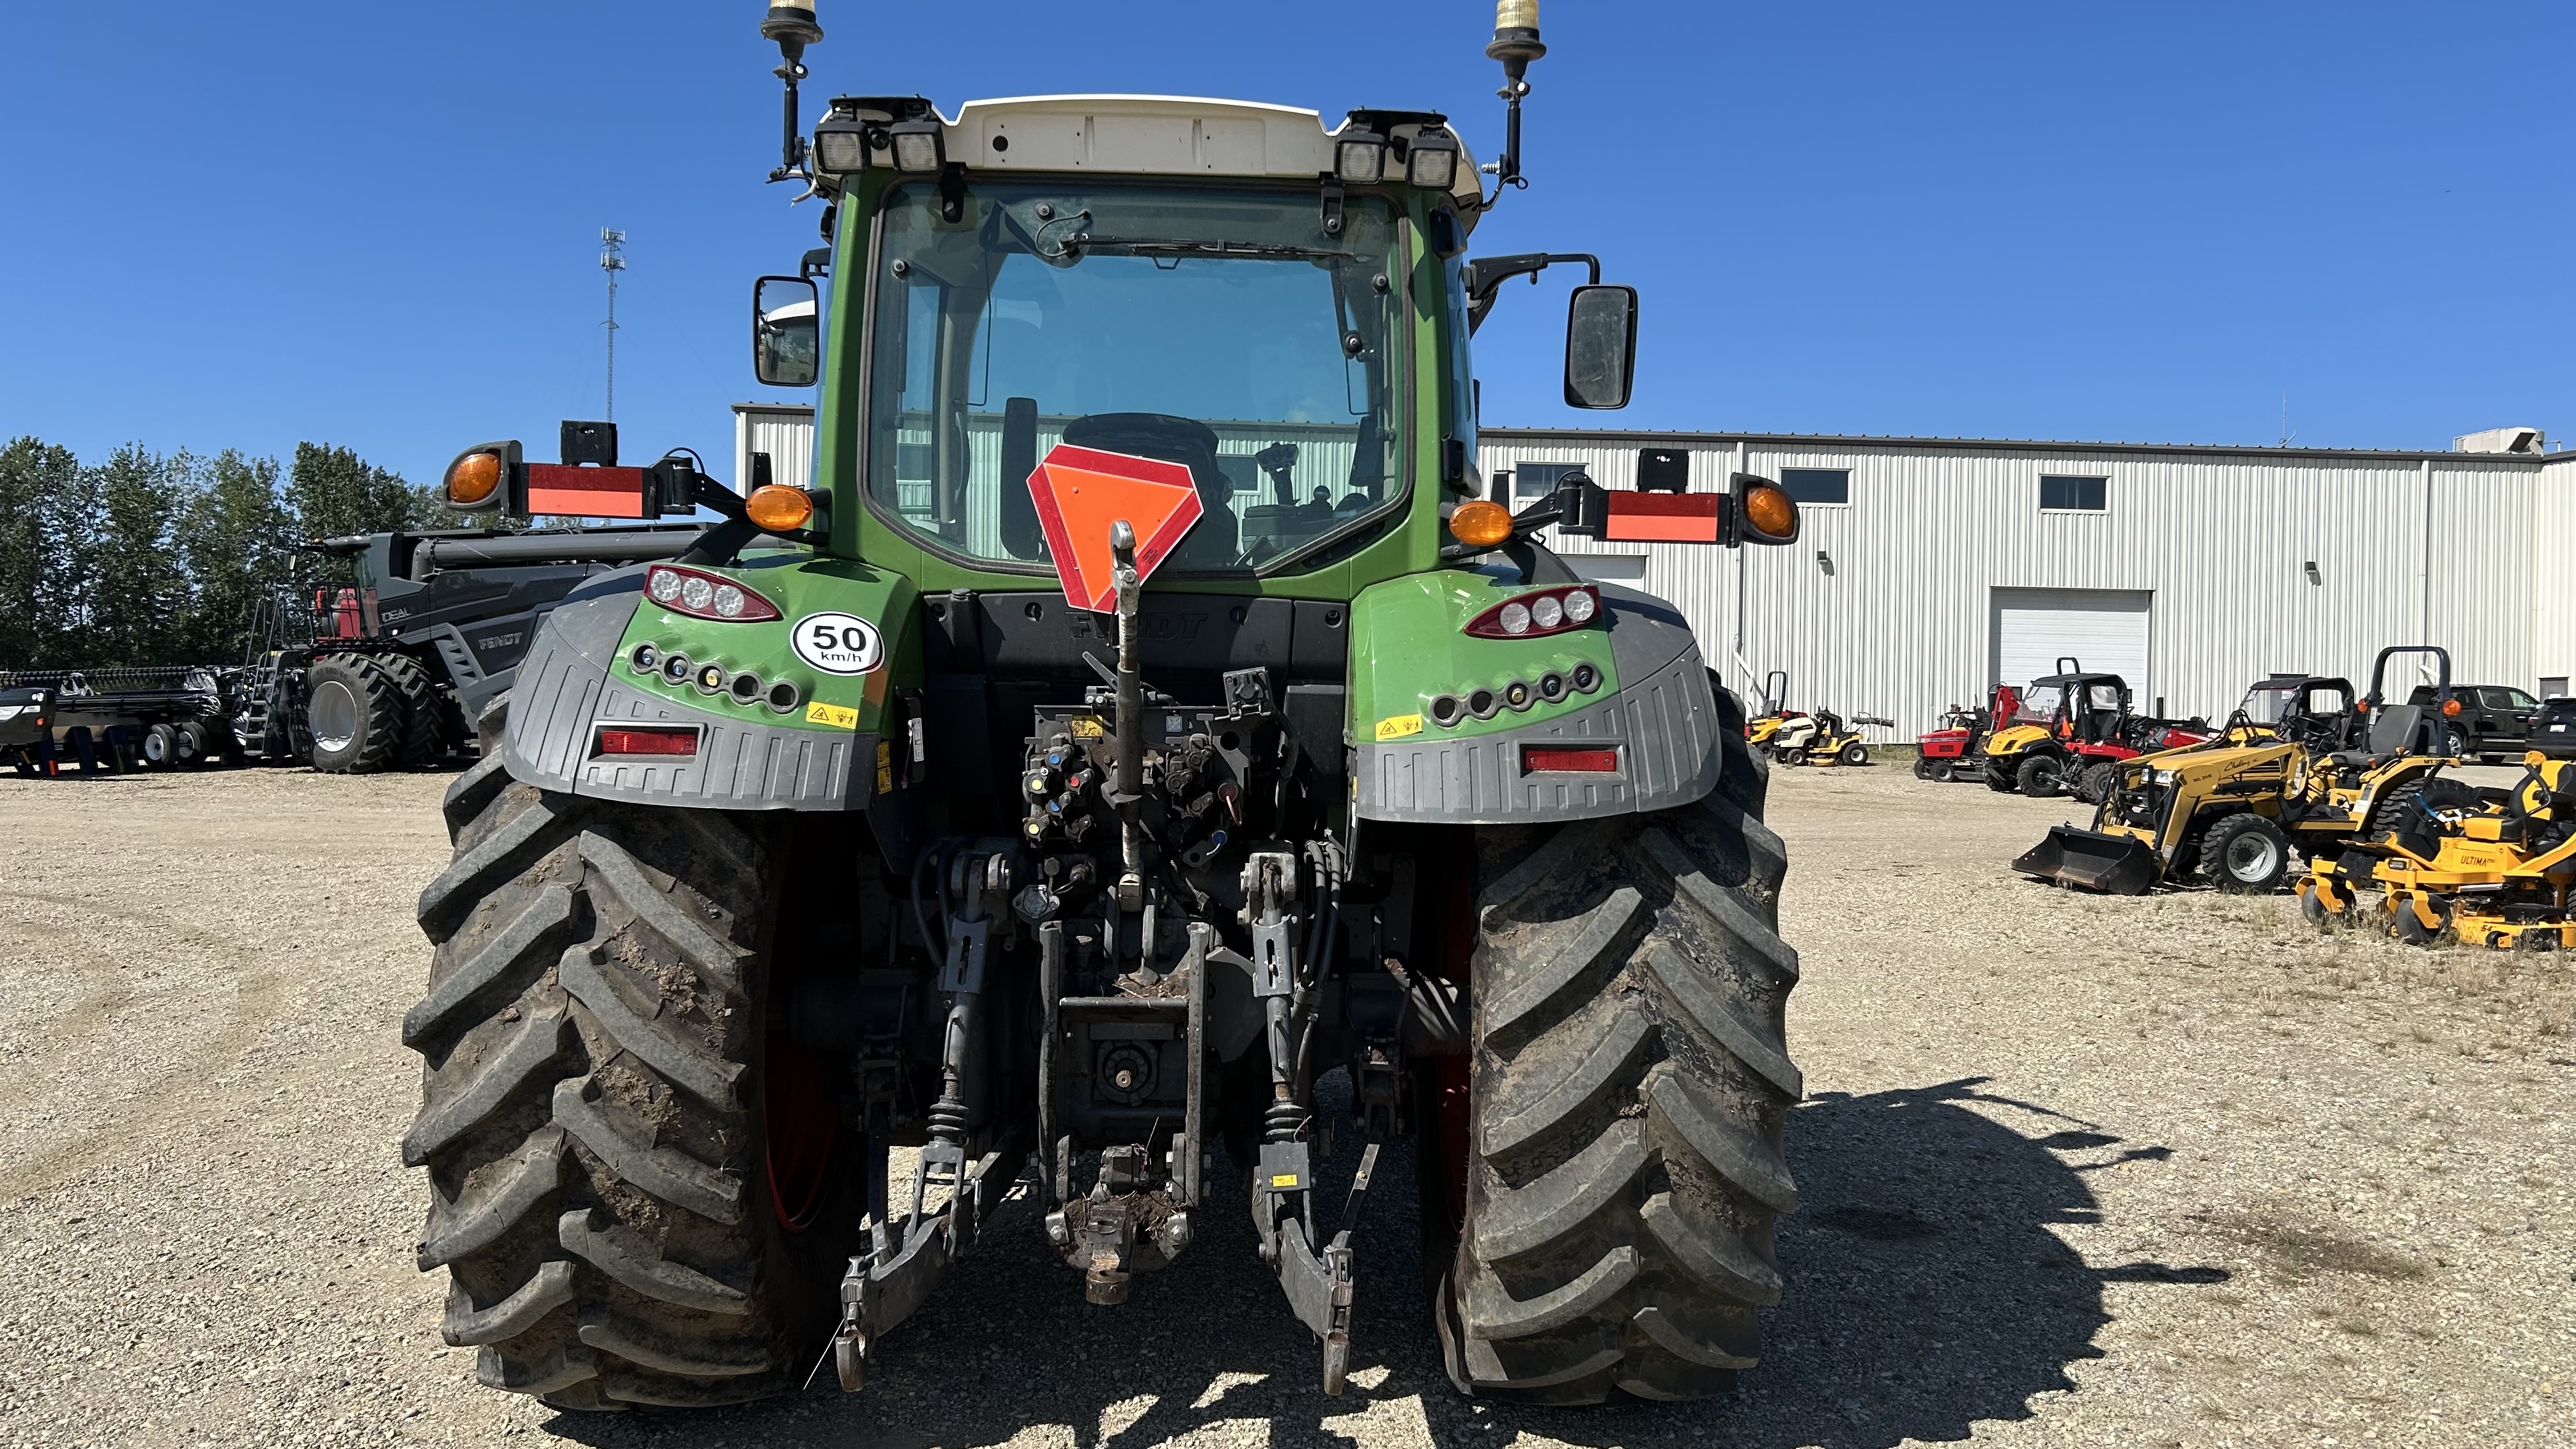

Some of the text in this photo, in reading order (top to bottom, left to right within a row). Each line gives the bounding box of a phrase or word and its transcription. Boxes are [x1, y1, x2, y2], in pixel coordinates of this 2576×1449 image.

[381, 607, 412, 622] IDEAL
[478, 631, 523, 650] FENDT
[813, 625, 866, 652] 50
[821, 652, 862, 663] km/h
[2460, 855, 2487, 867] ULTIMA
